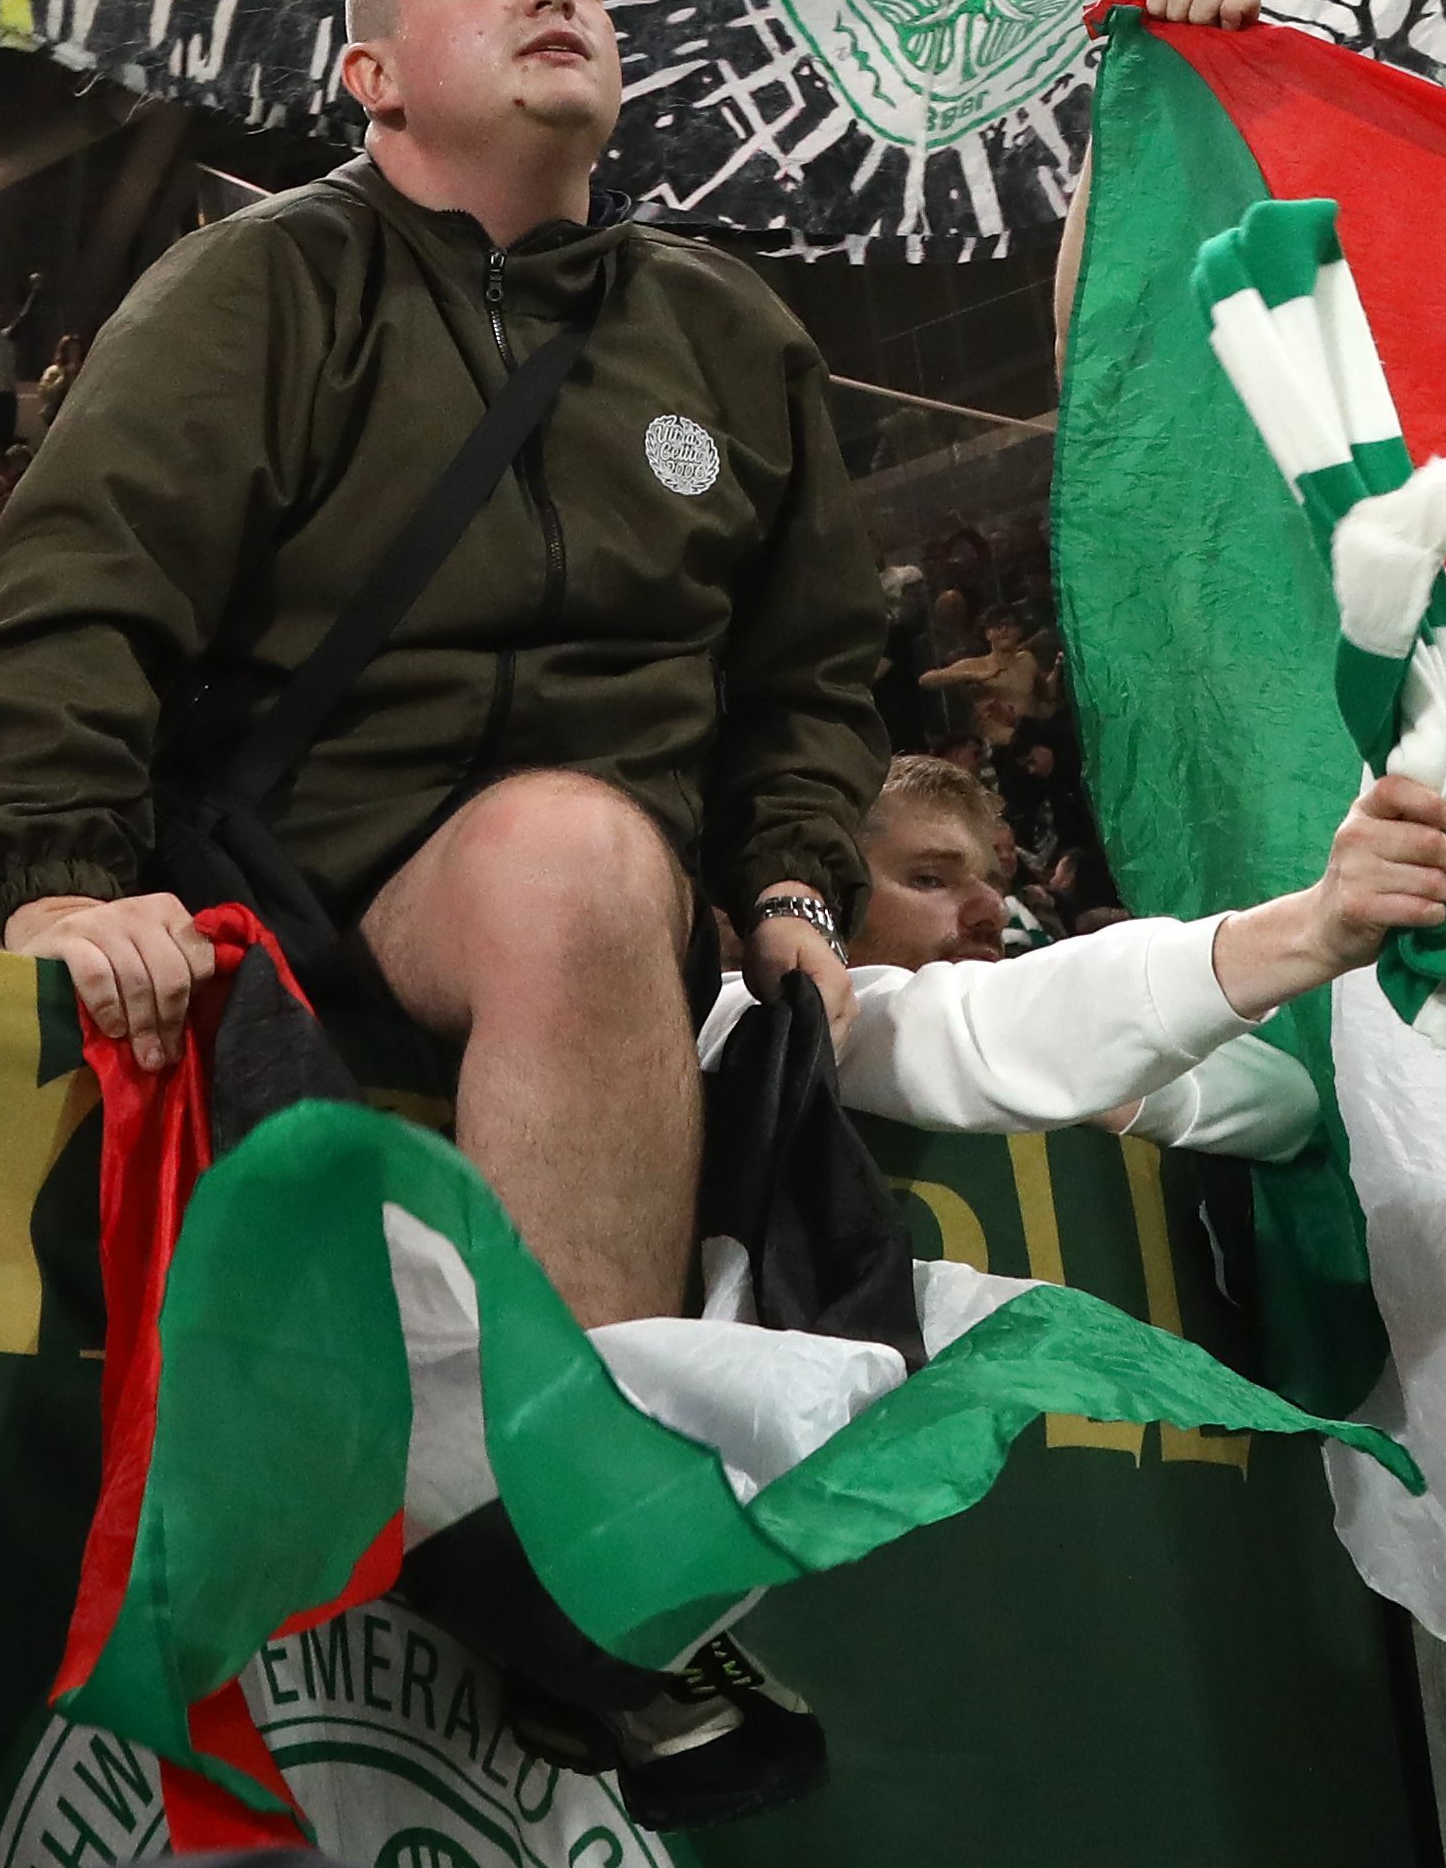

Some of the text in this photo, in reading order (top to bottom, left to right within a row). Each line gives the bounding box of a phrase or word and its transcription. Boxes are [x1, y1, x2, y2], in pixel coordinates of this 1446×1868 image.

[655, 423, 702, 448] Ultras
[660, 441, 704, 463] Celtic
[665, 460, 705, 478] 2006
